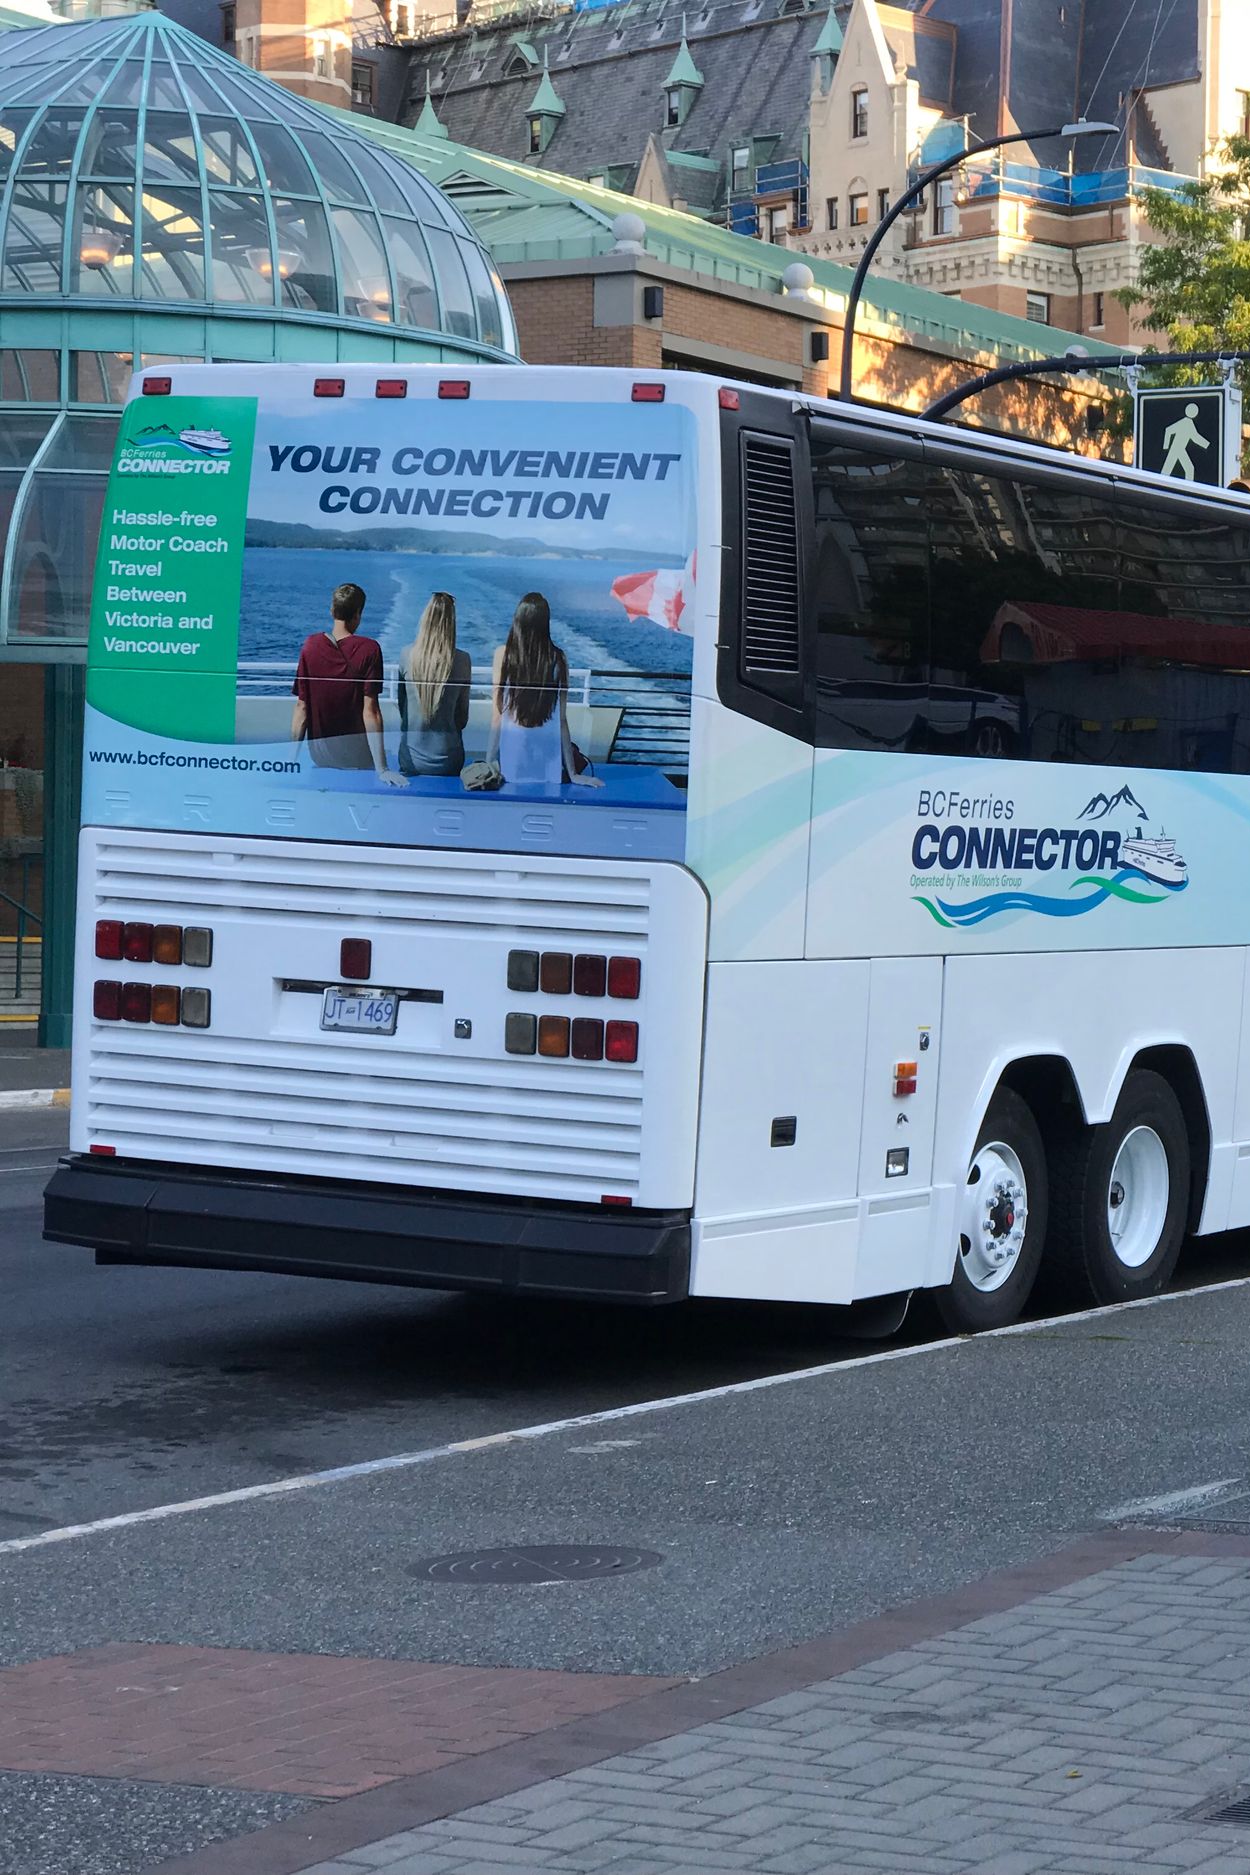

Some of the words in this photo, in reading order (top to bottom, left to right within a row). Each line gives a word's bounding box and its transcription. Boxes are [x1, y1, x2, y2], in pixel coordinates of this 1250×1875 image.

[117, 458, 231, 475] CONNECTOR
[268, 445, 381, 474] YOUR
[391, 447, 682, 481] CONVENIENT
[318, 485, 611, 520] CONNECTION
[112, 509, 218, 527] Hassle-free
[110, 534, 165, 552] Motor
[168, 536, 228, 553] Coach
[108, 560, 162, 577] Travel
[106, 585, 187, 603] Between
[104, 611, 173, 629] Victoria
[178, 614, 213, 630] and
[103, 637, 201, 655] Vancouver
[89, 750, 301, 774] www.bcfconnector.com
[911, 824, 1122, 871] CONNECTOR
[910, 874, 945, 889] Operated
[946, 874, 956, 889] by
[957, 874, 970, 887] The
[971, 874, 1000, 887] Wilson's
[1001, 874, 1023, 889] Group
[357, 1001, 394, 1023] 1469
